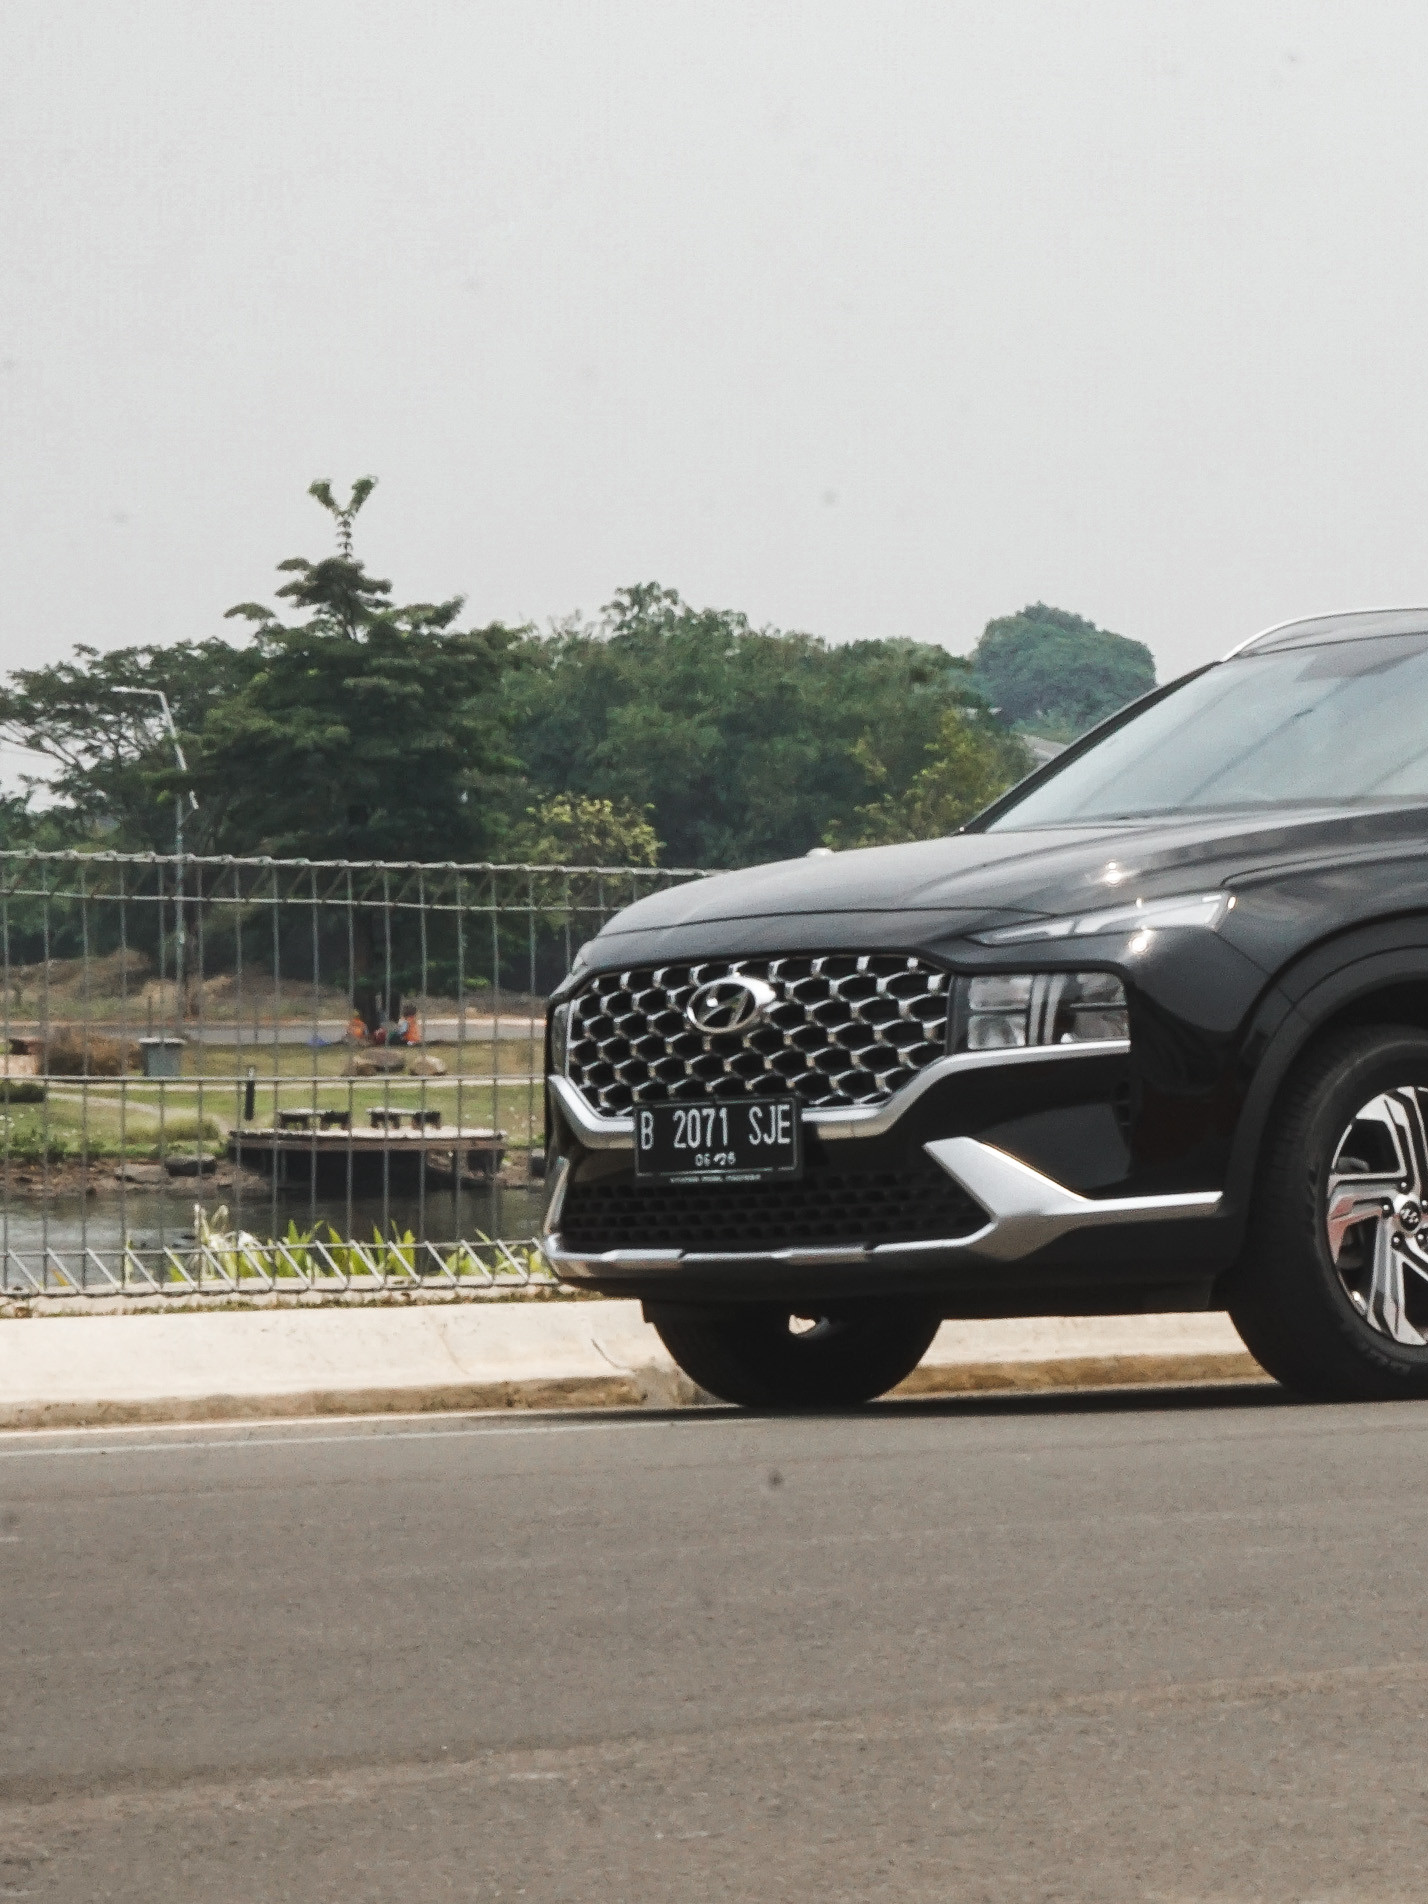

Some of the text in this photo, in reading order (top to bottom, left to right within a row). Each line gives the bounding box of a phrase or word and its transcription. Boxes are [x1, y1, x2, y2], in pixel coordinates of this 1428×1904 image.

[641, 1104, 791, 1150] B 2071 SJE
